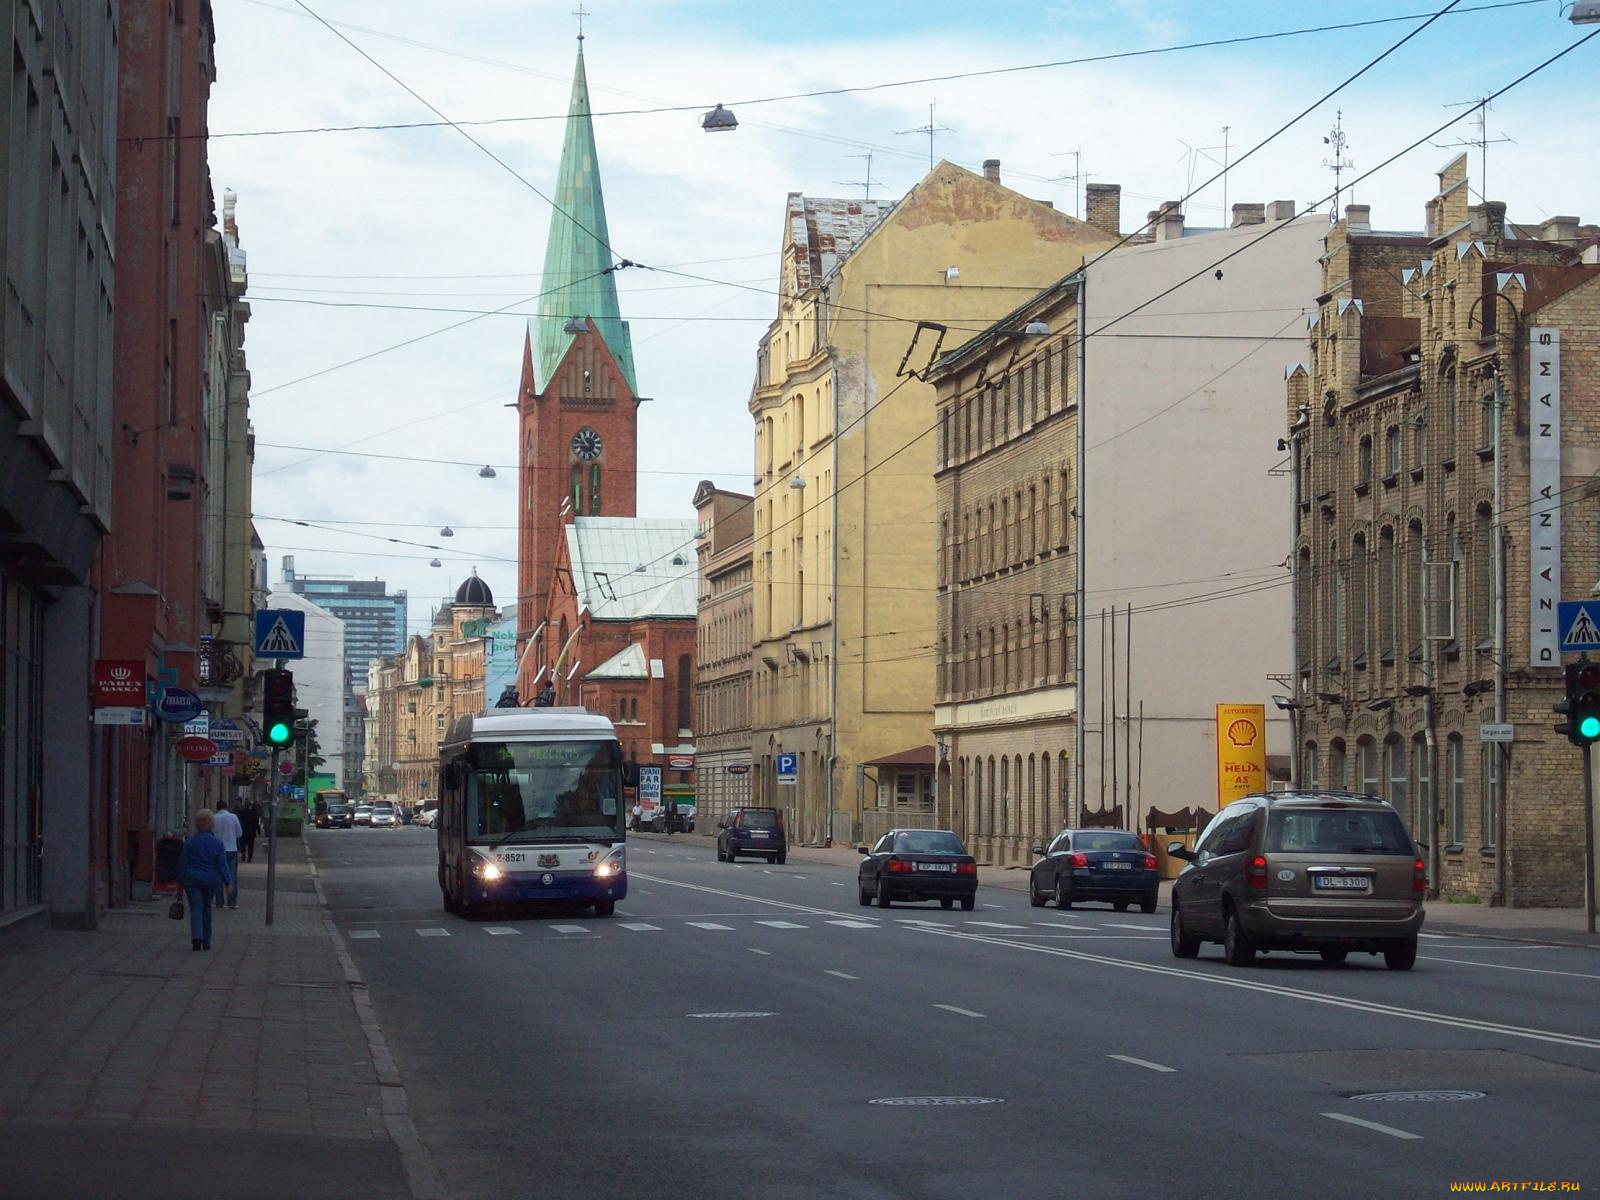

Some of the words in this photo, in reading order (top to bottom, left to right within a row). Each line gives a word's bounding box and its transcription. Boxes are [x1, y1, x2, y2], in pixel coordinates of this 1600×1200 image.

[1540, 332, 1551, 437] NAMS
[1540, 485, 1552, 662] DIZAINA
[781, 757, 793, 773] P
[1225, 762, 1261, 773] HELIX
